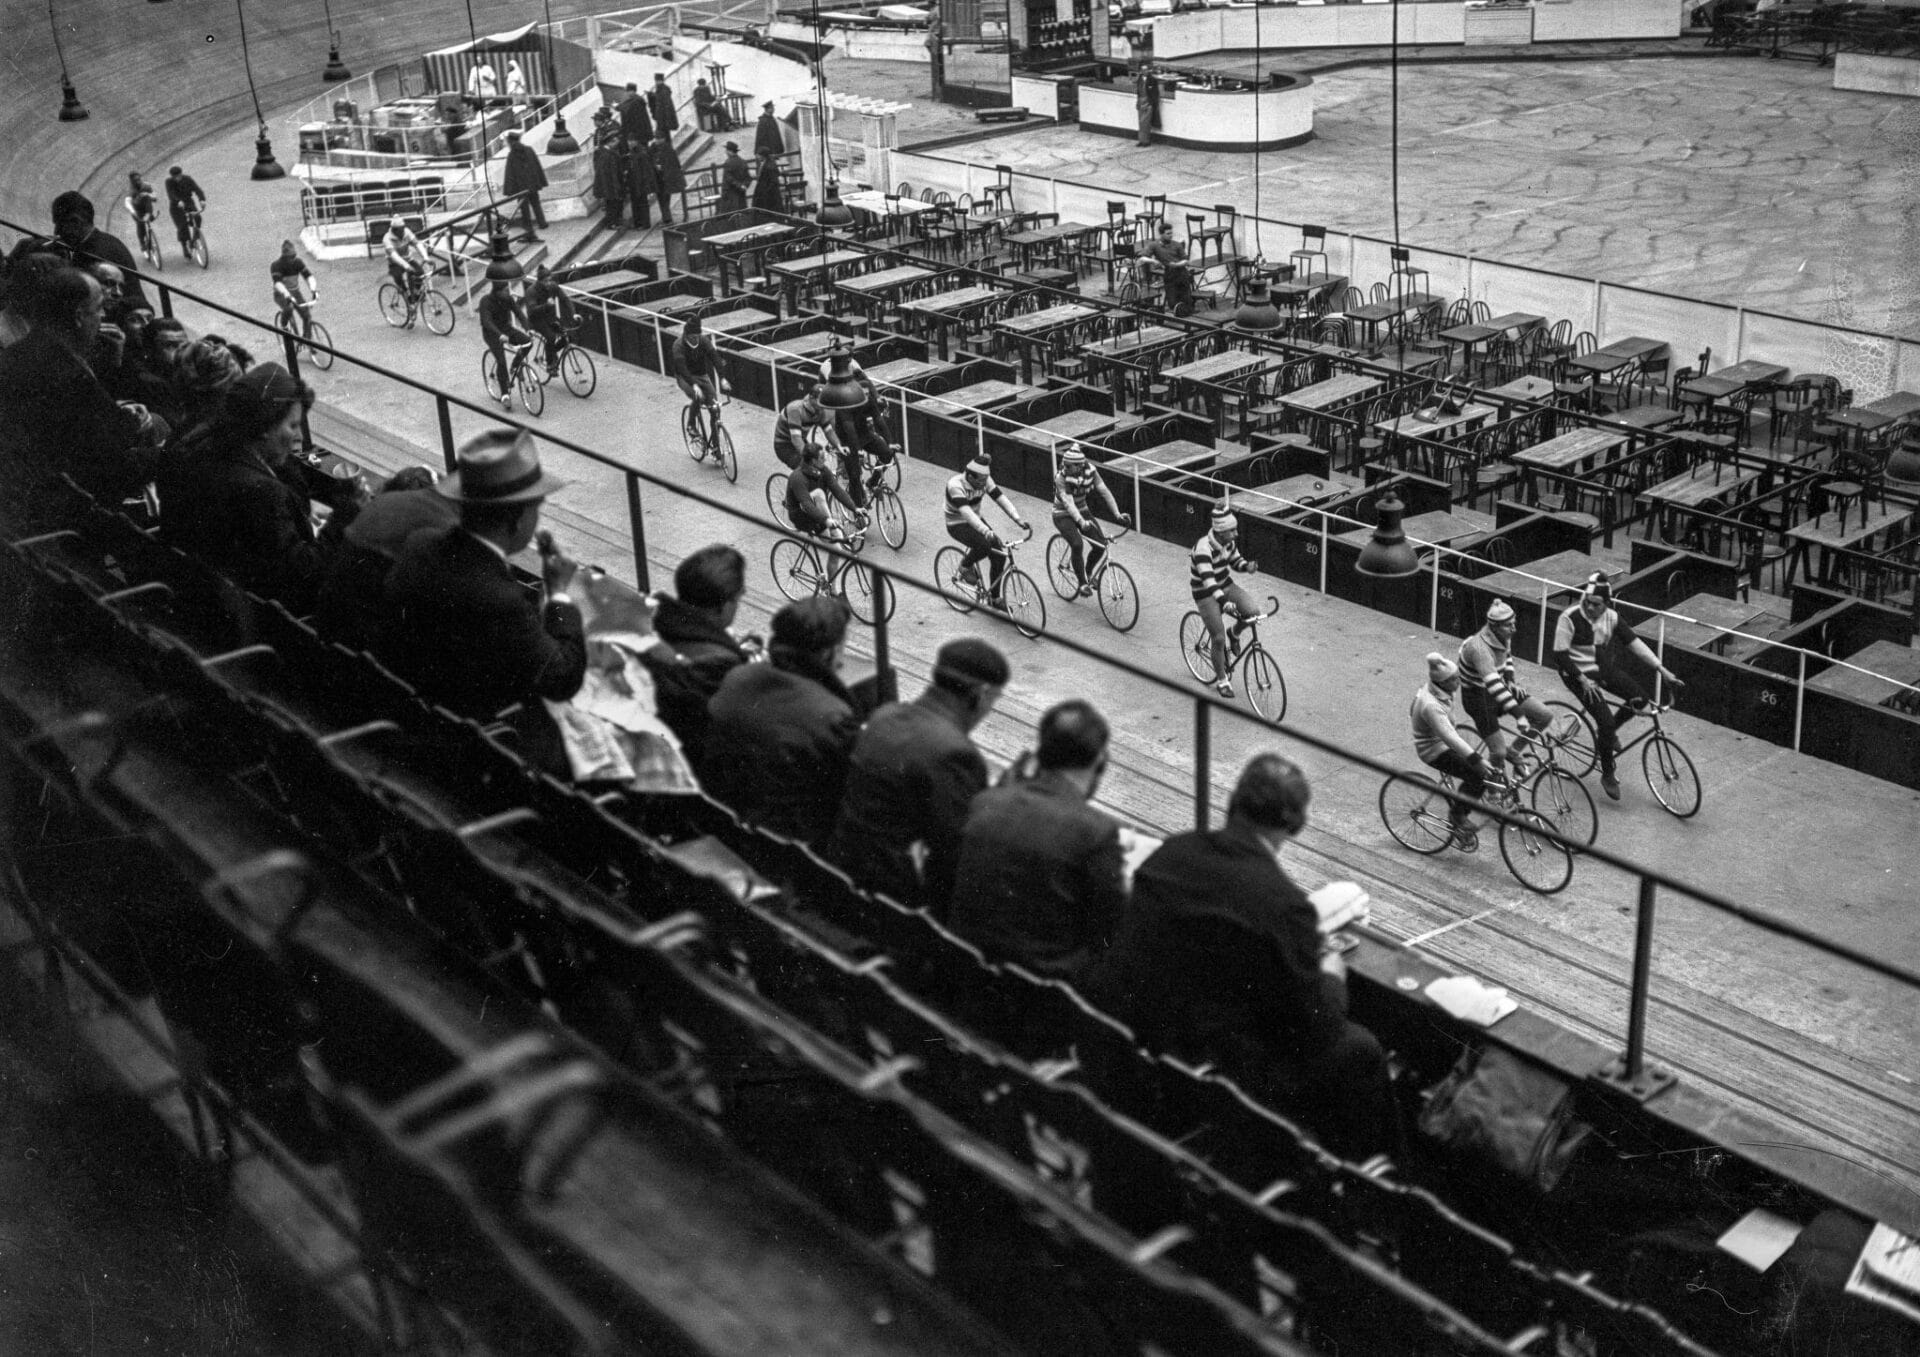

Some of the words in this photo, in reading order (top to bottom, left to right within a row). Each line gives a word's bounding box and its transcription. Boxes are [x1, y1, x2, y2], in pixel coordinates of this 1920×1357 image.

[1306, 542, 1318, 555] 20
[1440, 586, 1453, 600] 22
[1761, 690, 1777, 705] 26
